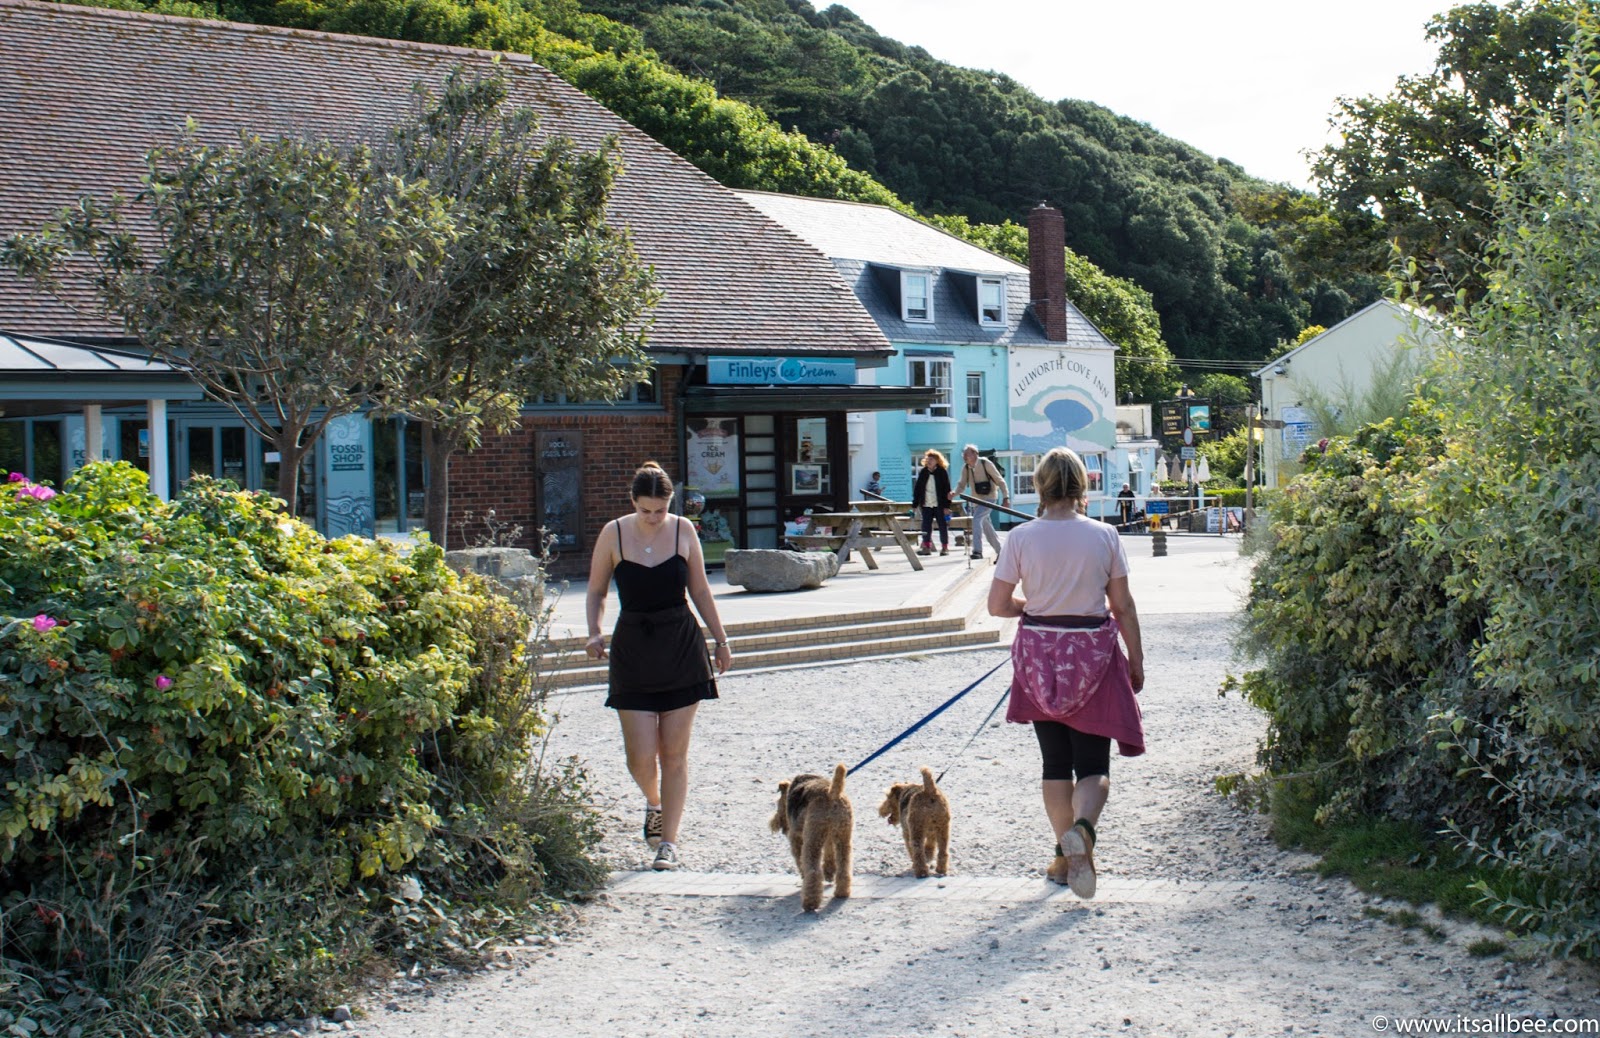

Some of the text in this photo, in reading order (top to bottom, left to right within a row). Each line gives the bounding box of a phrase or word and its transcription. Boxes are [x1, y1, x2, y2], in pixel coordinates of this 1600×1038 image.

[728, 362, 837, 382] Finleys Ice Cream
[1014, 358, 1110, 399] LULWORTH COVE INN
[72, 449, 112, 459] FOIL
[331, 444, 366, 454] FOSSIL
[332, 453, 363, 463] SHOP
